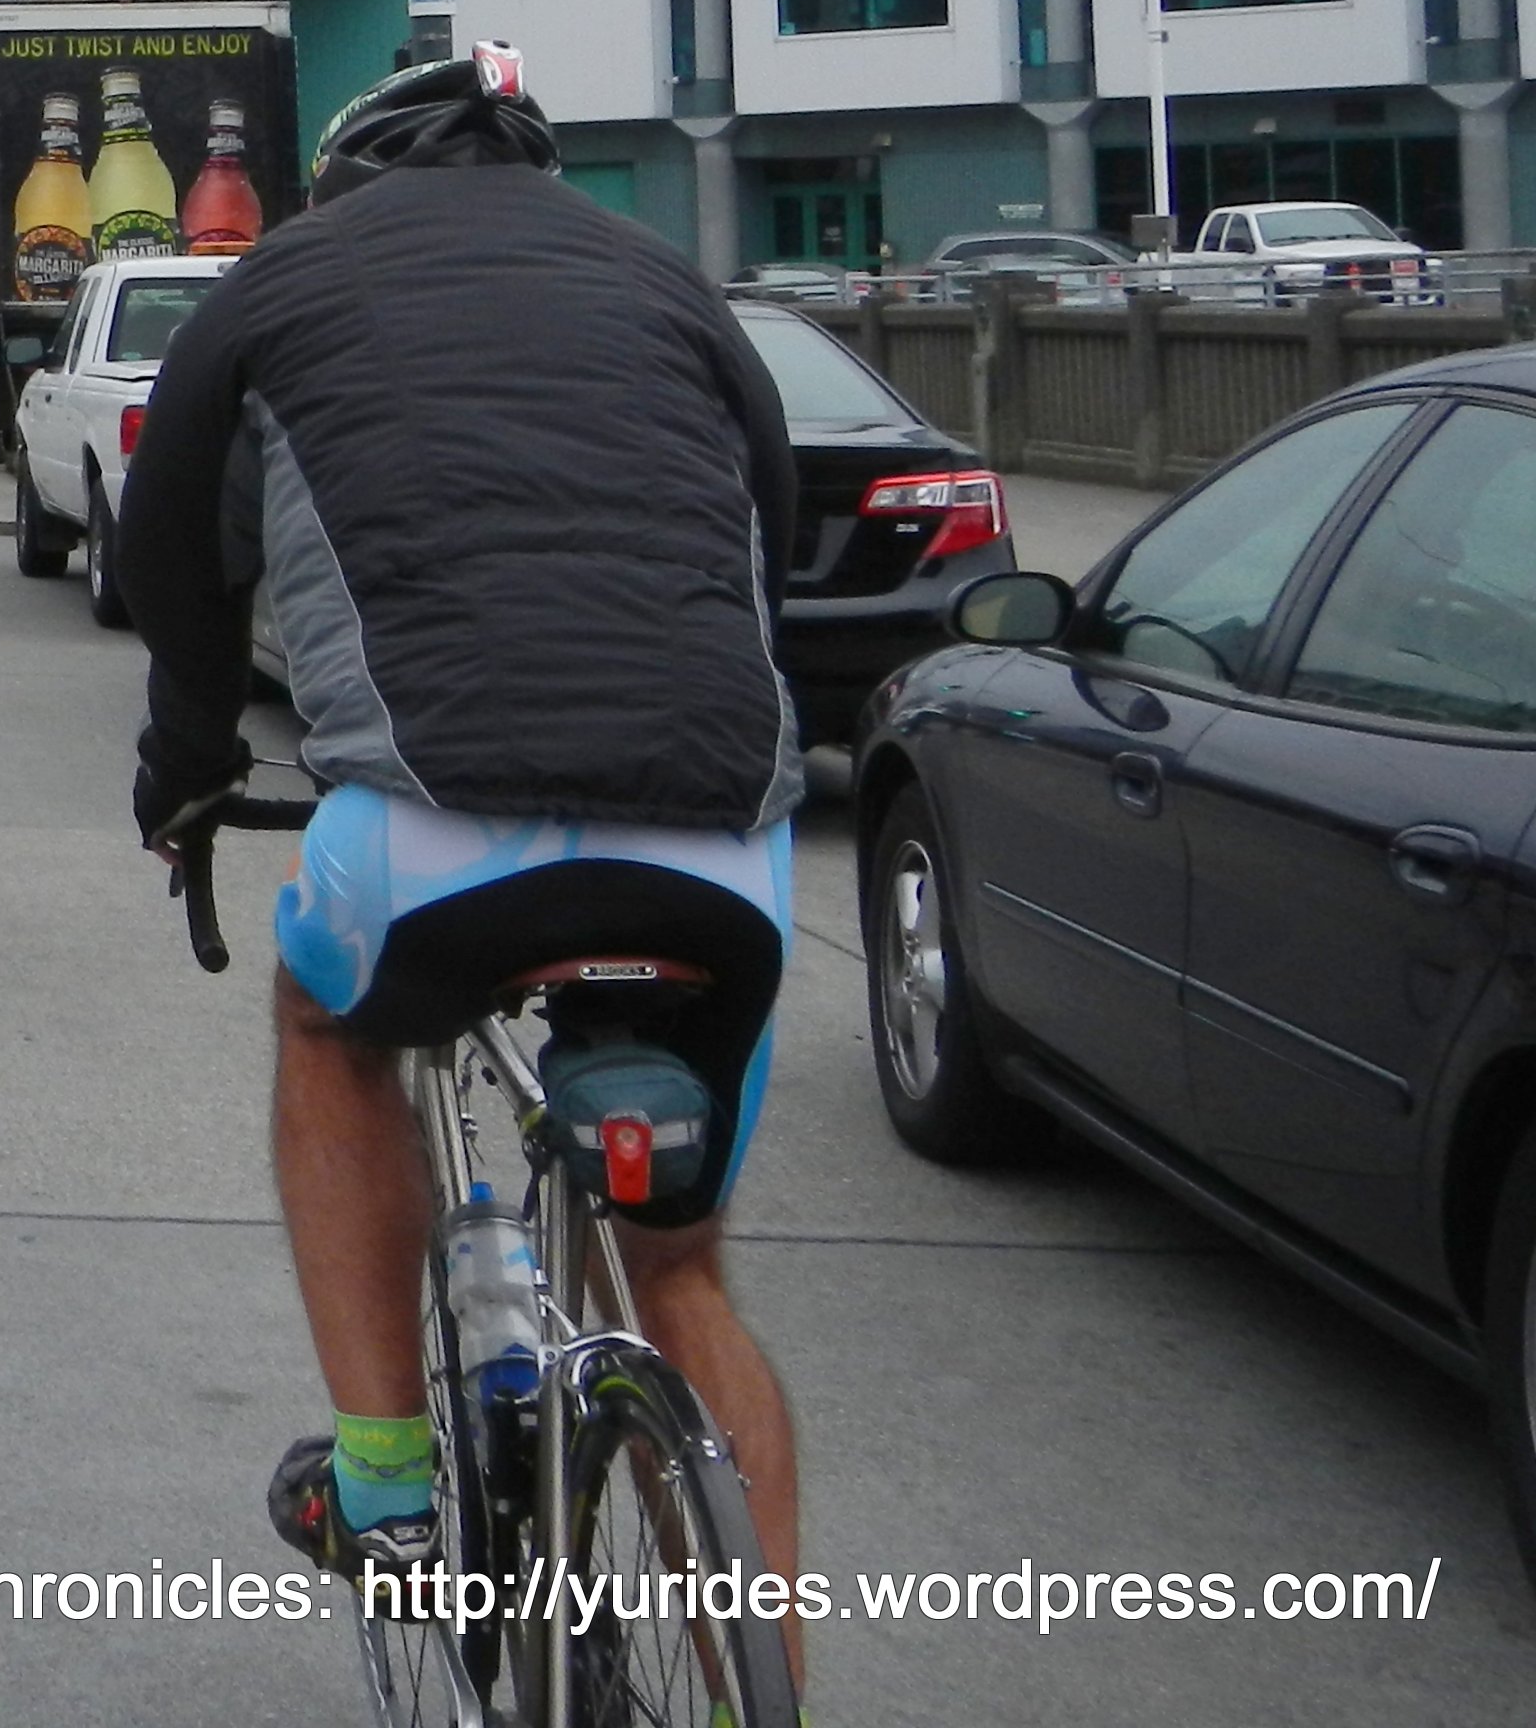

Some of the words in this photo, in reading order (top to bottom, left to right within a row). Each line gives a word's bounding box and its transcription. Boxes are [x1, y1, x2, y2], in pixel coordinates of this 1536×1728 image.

[1, 37, 55, 58] JUST
[64, 35, 125, 58] TWIST
[132, 35, 176, 56] AND
[182, 33, 251, 56] ENJOY
[18, 255, 85, 276] MARGARITA
